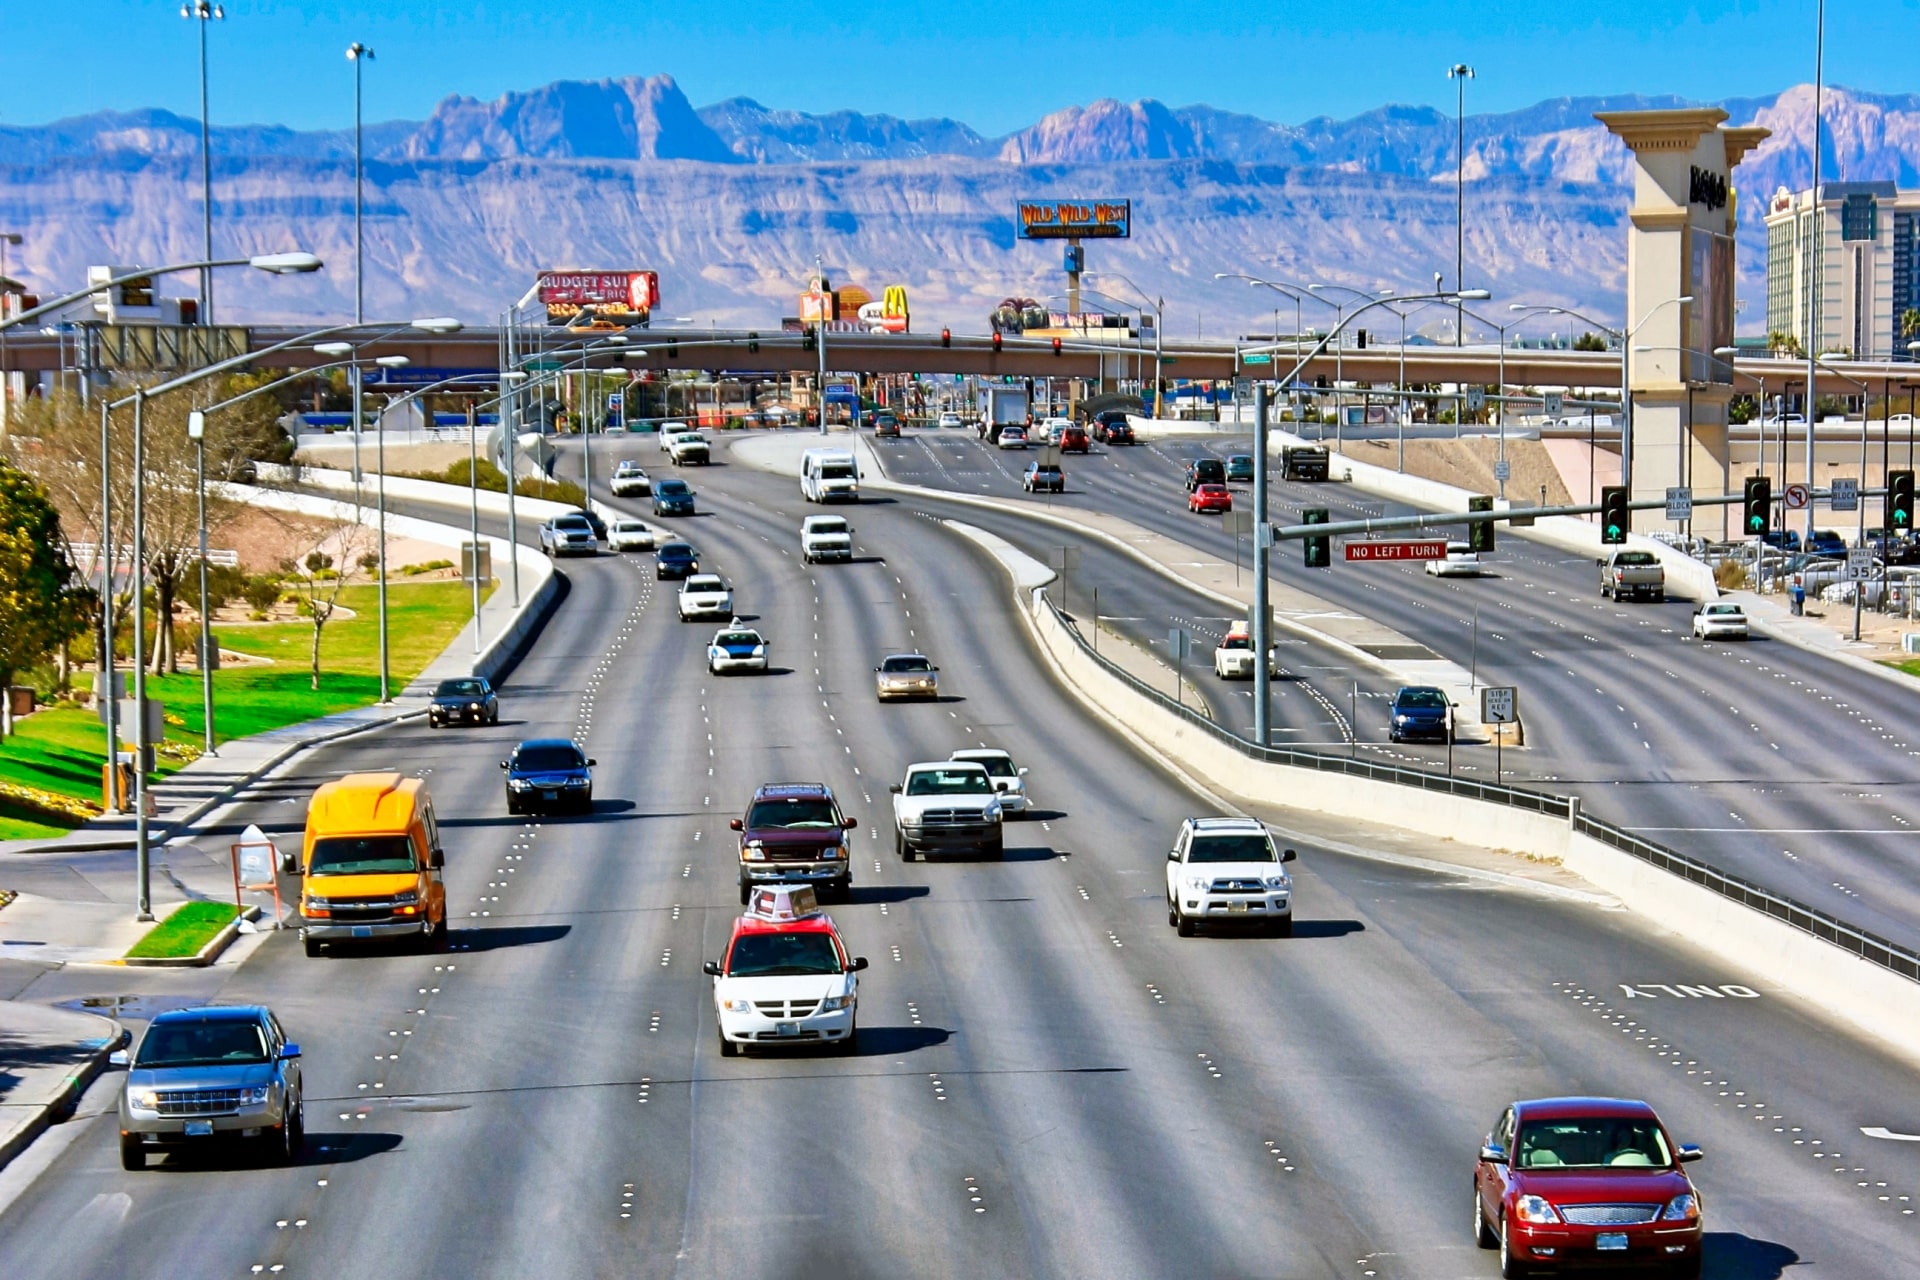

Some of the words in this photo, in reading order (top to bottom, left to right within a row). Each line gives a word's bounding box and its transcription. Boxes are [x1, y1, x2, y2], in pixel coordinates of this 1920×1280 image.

[1020, 203, 1053, 226] WILD
[1057, 203, 1090, 226] WILD
[541, 275, 599, 288] BUDGET
[1667, 502, 1690, 510] BLOCK
[1352, 547, 1368, 558] NO
[1375, 546, 1401, 557] LEFT
[1409, 545, 1439, 556] TURN
[1851, 567, 1870, 578] 35
[1618, 984, 1760, 998] ONLY
